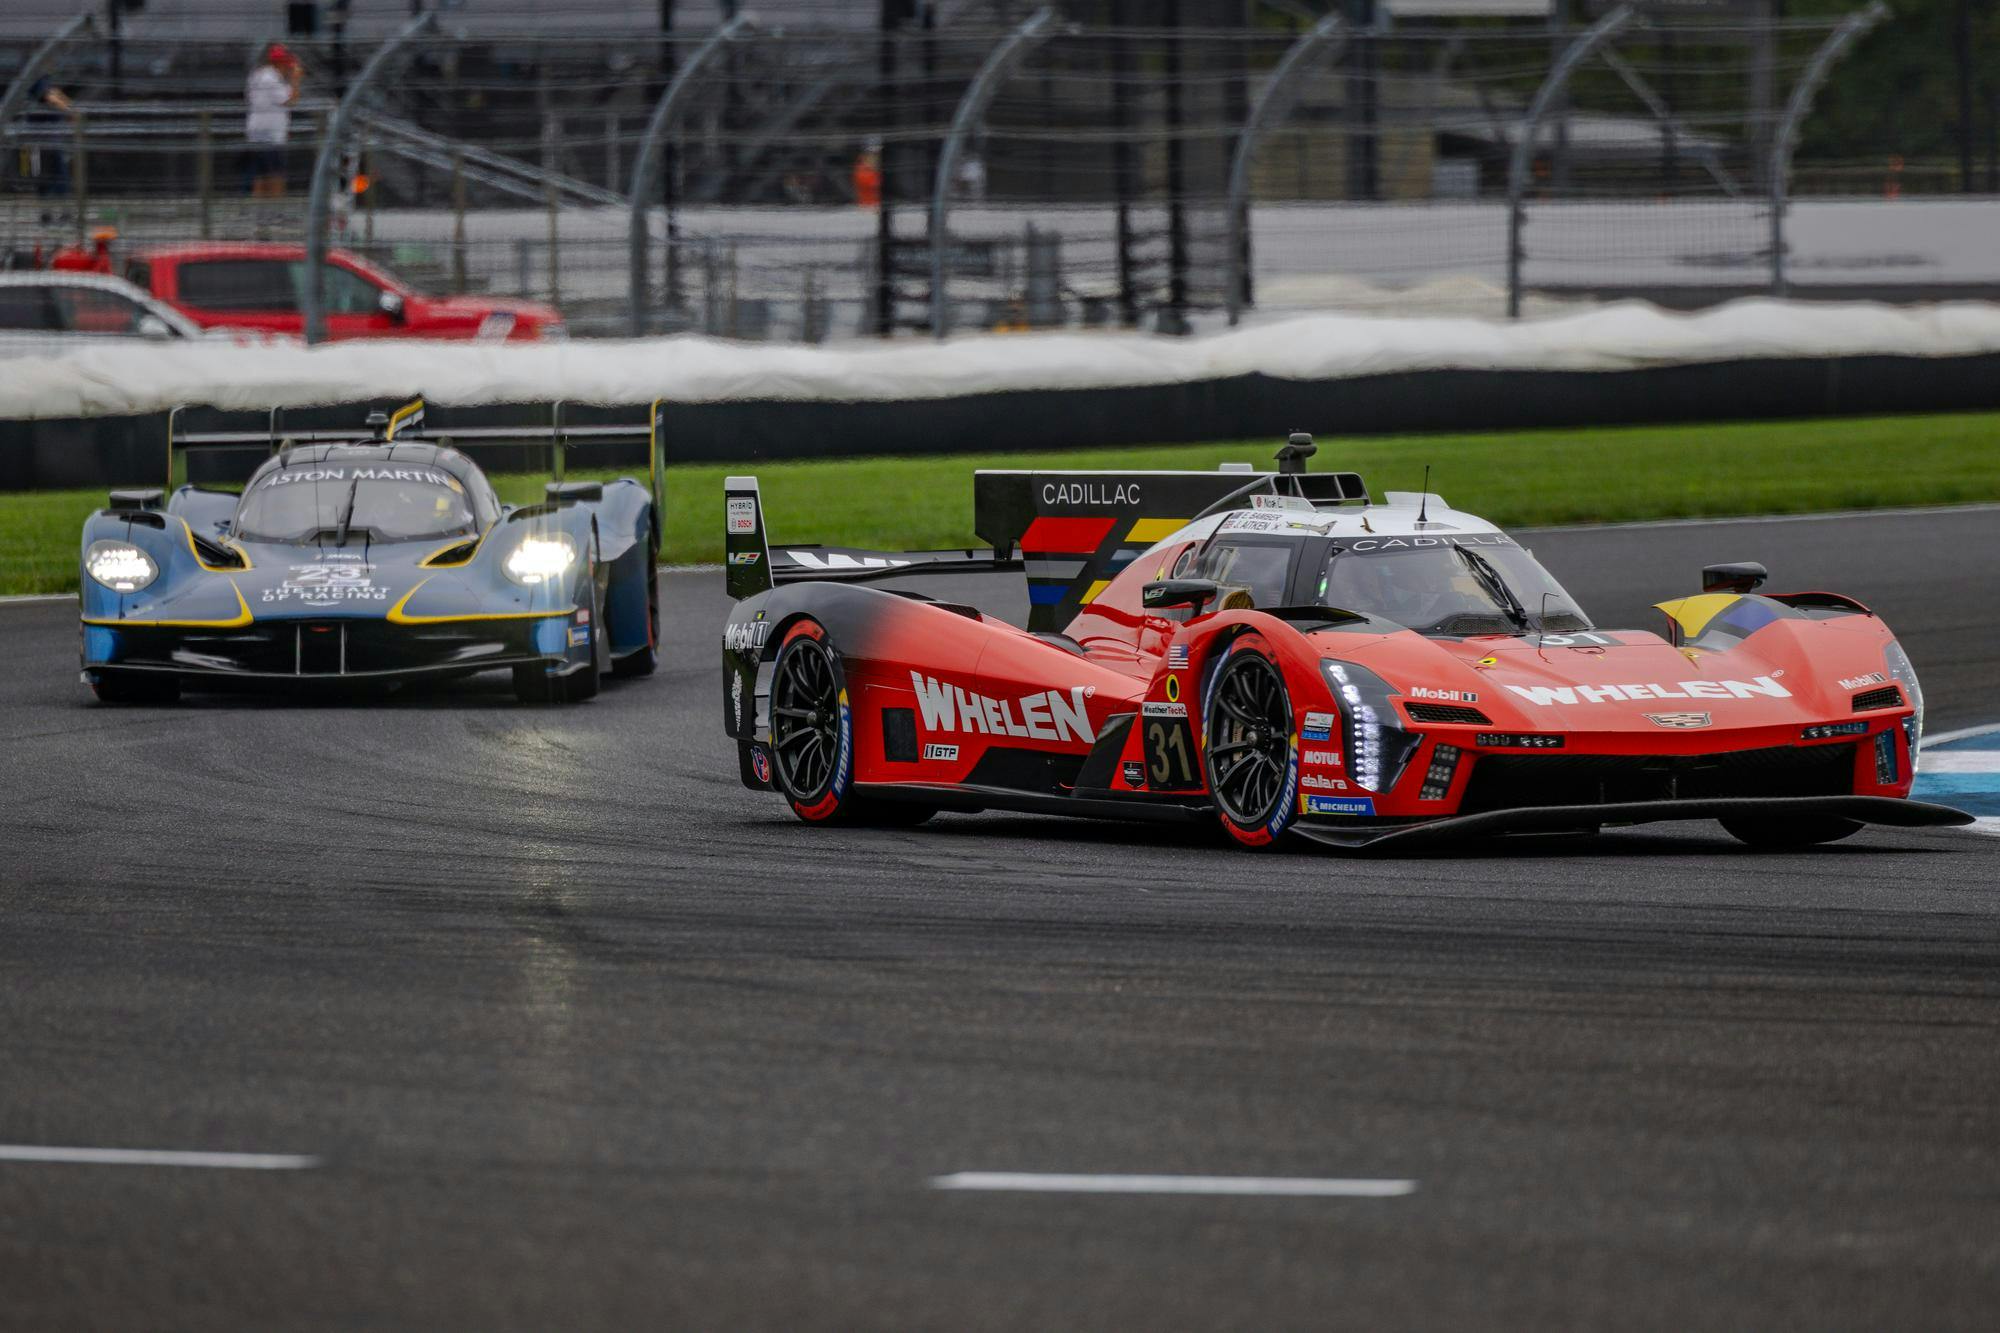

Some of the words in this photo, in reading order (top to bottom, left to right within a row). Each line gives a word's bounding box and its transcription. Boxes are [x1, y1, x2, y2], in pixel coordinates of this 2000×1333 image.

[262, 469, 344, 490] ASTON
[351, 469, 449, 488] MARTIN
[1042, 483, 1141, 505] CADILLAC
[737, 520, 752, 528] BOSCH
[1241, 521, 1272, 530] AITKEN
[297, 568, 361, 580] 23
[262, 587, 305, 596] THE
[262, 594, 290, 602] OF
[300, 592, 387, 600] RACING
[725, 622, 756, 650] Mobil
[1837, 673, 1876, 690] Mobil
[1411, 687, 1459, 702] Mobil
[1504, 676, 1793, 706] WHELEN
[910, 670, 1096, 744] WHELEN
[1144, 705, 1184, 715] WeatherTech
[834, 719, 850, 794] MICHELIN
[934, 747, 957, 757] GTP
[1149, 722, 1193, 783] 31
[1303, 751, 1341, 766] MOTUL
[1301, 774, 1348, 790] dallara
[1271, 763, 1298, 833] MICHELIN
[1320, 802, 1367, 812] MICHELIN
